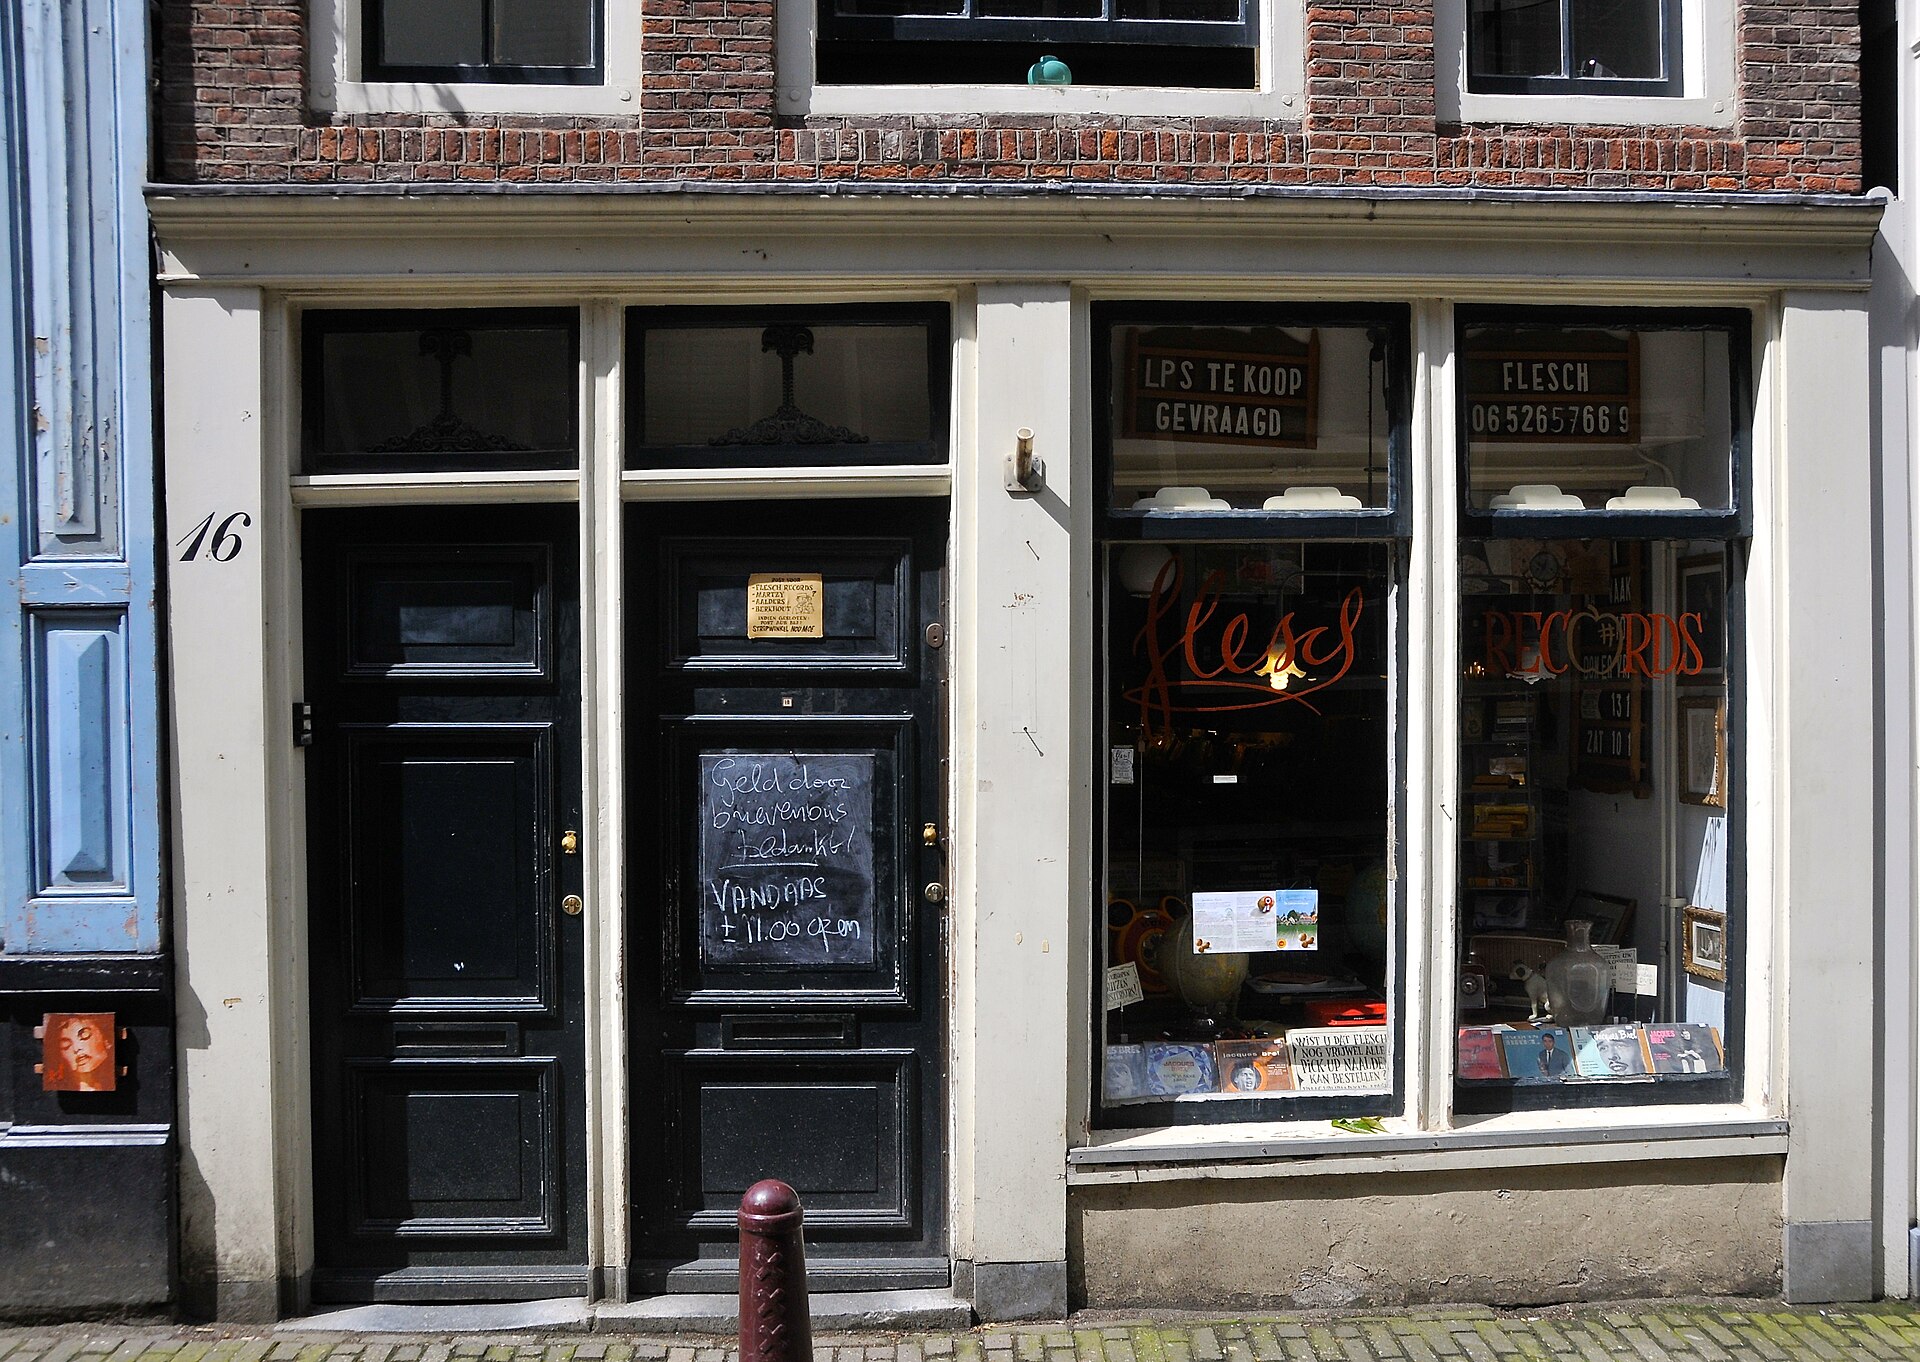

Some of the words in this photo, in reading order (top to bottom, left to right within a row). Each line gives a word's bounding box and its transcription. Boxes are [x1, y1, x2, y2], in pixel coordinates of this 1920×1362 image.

[1145, 358, 1194, 390] LPS
[1207, 362, 1236, 393] TE
[1243, 364, 1302, 396] KOOP
[1502, 361, 1590, 393] FLESCH
[1155, 401, 1281, 437] GEVRAAGD
[175, 511, 252, 562] 16
[783, 584, 814, 592] RECORDS
[1481, 604, 1704, 679] RECORDS
[1586, 729, 1604, 755] ZAT
[711, 758, 784, 808] Geld
[788, 764, 851, 790] door
[711, 798, 848, 829] brievenbus
[806, 916, 861, 953] open
[1302, 1047, 1323, 1058] NOG
[1365, 1045, 1385, 1056] ALLE
[1323, 1035, 1331, 1046] U
[1334, 1034, 1350, 1046] DAT
[1309, 1073, 1330, 1084] KAN
